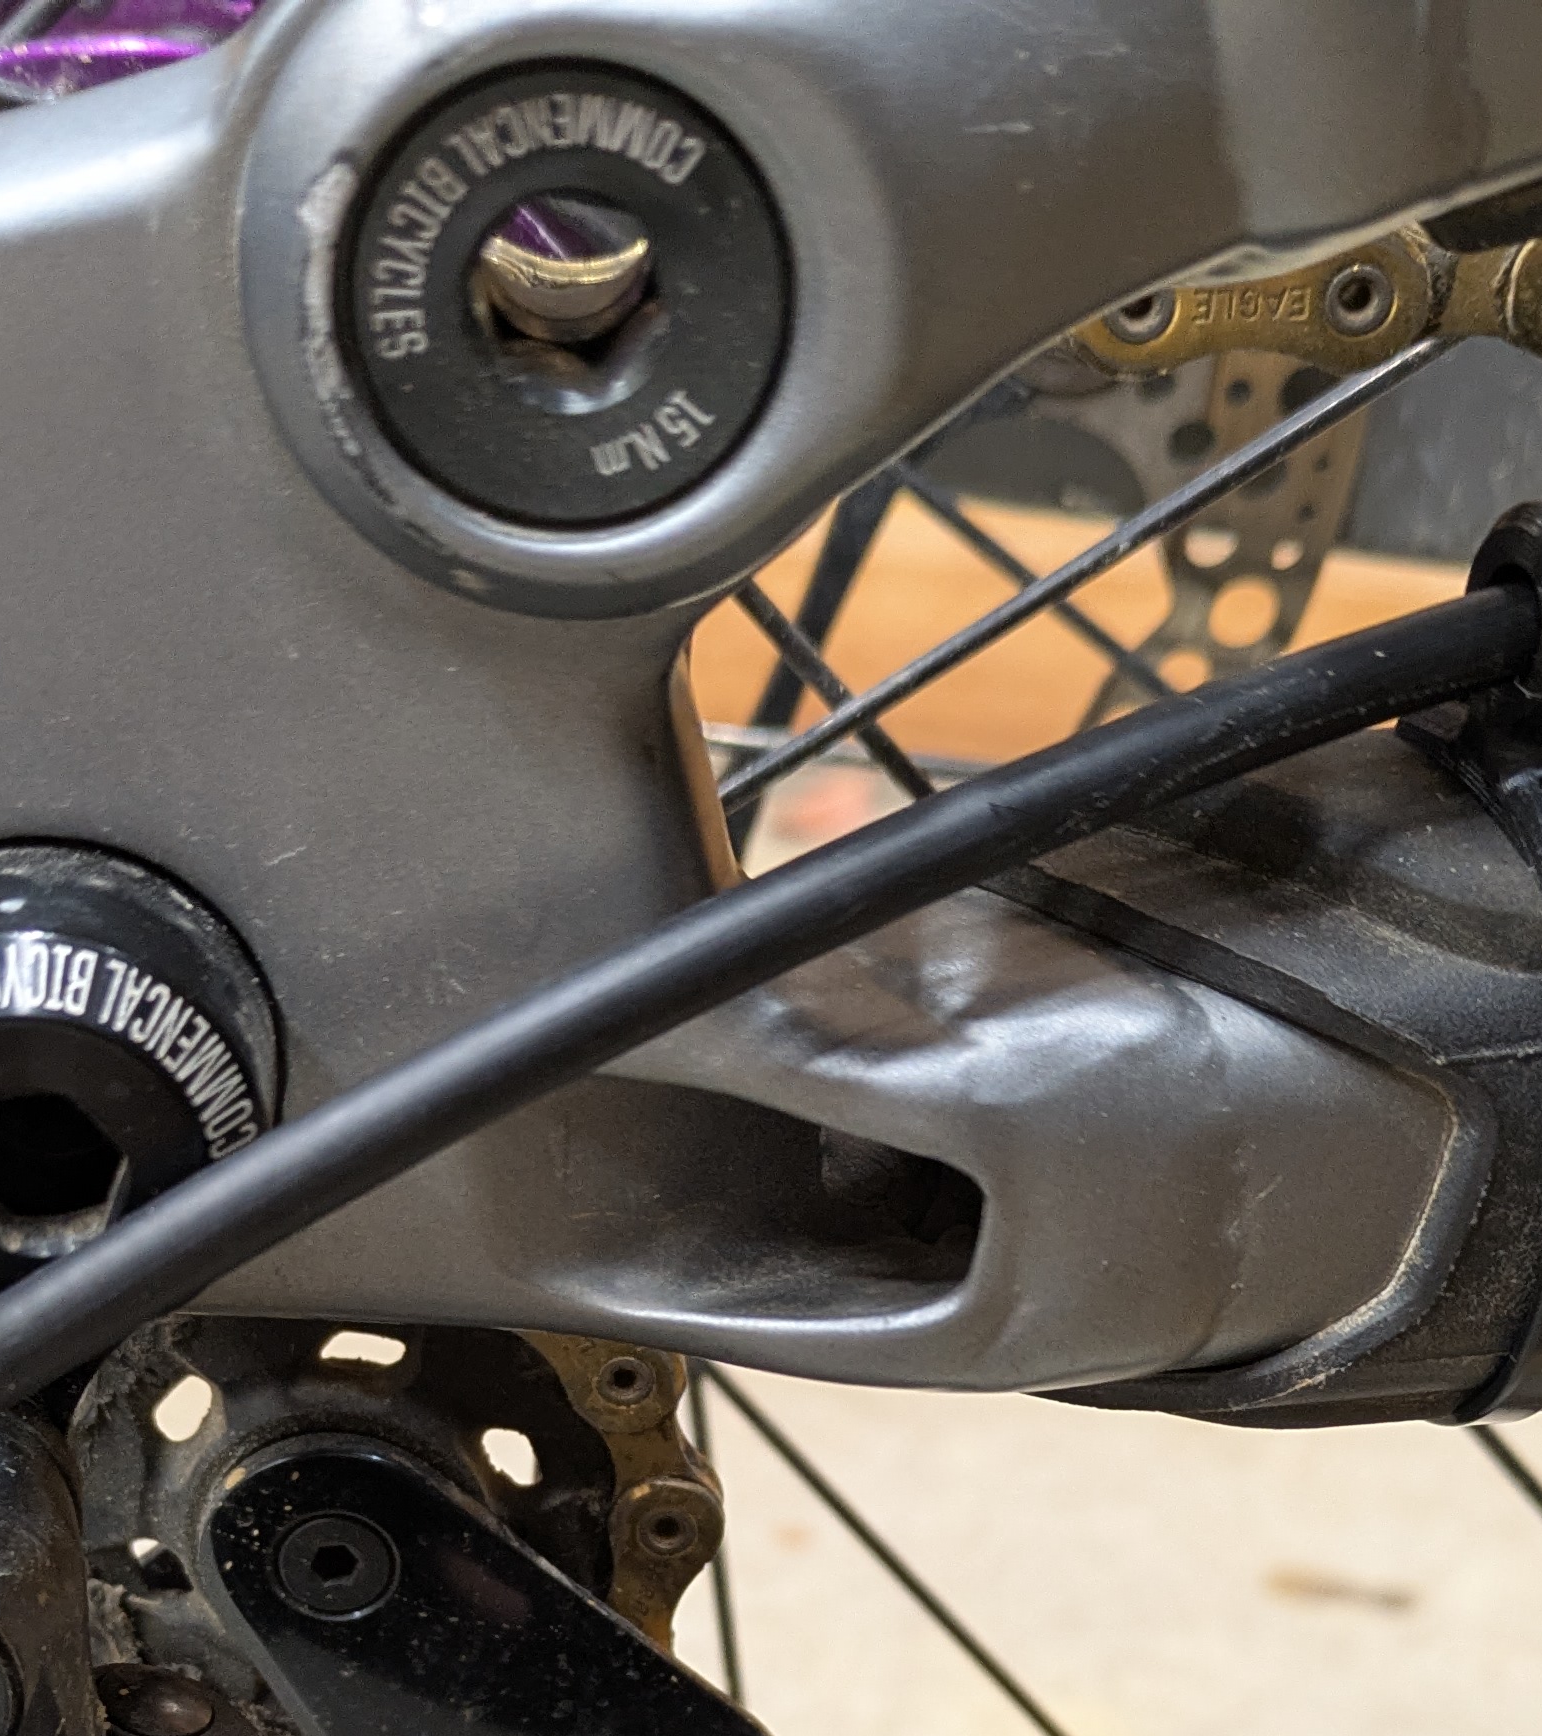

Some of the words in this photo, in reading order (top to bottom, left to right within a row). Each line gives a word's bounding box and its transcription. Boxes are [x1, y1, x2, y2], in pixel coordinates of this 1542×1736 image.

[442, 92, 706, 187] COMMENCAL
[370, 156, 468, 360] BICYCLES
[1191, 286, 1312, 323] EAGLE
[653, 389, 716, 449] 15
[98, 957, 258, 1161] COMMENCAL
